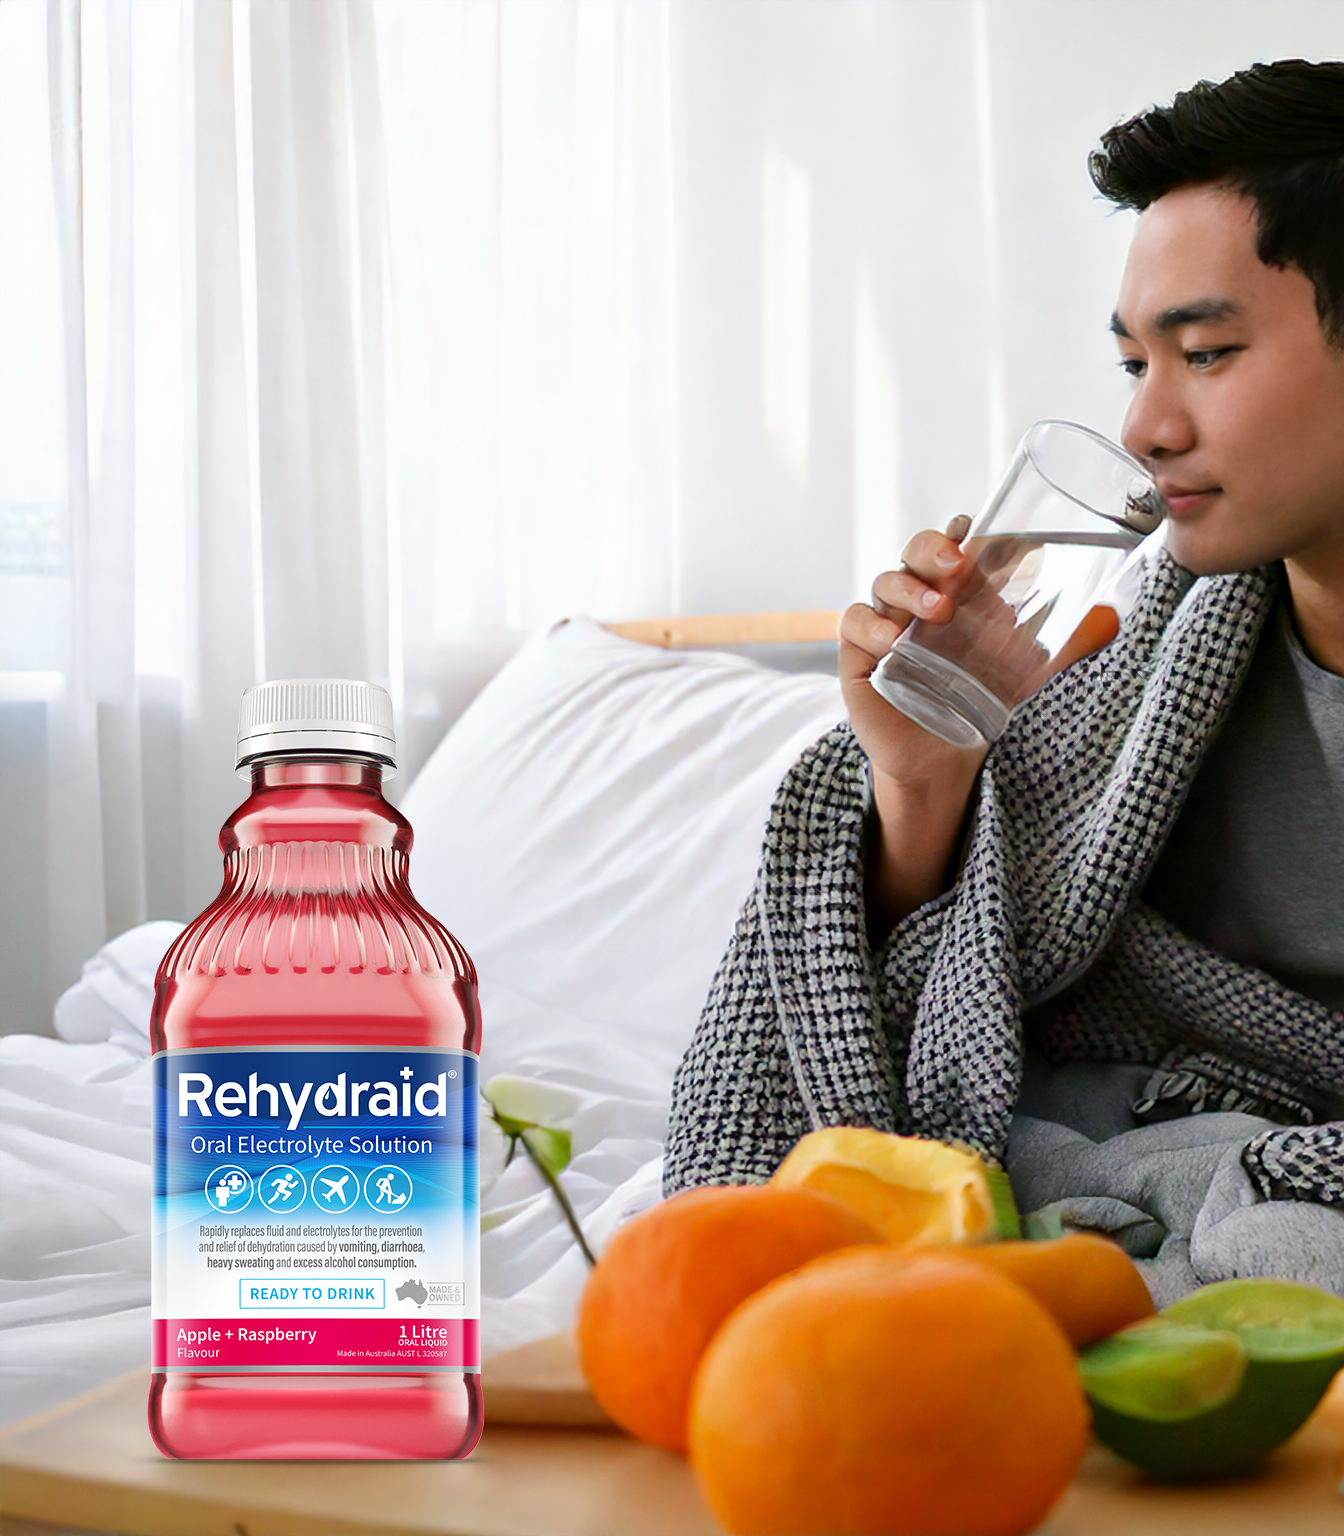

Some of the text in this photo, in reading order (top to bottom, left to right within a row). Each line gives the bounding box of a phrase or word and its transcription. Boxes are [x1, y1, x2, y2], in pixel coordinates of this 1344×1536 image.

[191, 1135, 433, 1158] Oral Electrolyte Solution
[199, 1225, 422, 1239] Rapidly replaces fluid and electrolytes for the prevention
[199, 1241, 425, 1255] and relief of dehydration caused by vomiting, diarrhoea,
[207, 1256, 417, 1270] heavy sweating and excess alcohol consumption.
[250, 1287, 375, 1300] READY TO DRINK
[429, 1285, 452, 1294] MADE
[429, 1293, 461, 1302] OWNED
[177, 1327, 221, 1344] Apple
[238, 1328, 317, 1344] Raspberry
[399, 1324, 448, 1339] 1 Litre
[398, 1338, 448, 1347] ORAL LIQUID
[177, 1347, 220, 1358] Flavour
[365, 1349, 396, 1357] Australia
